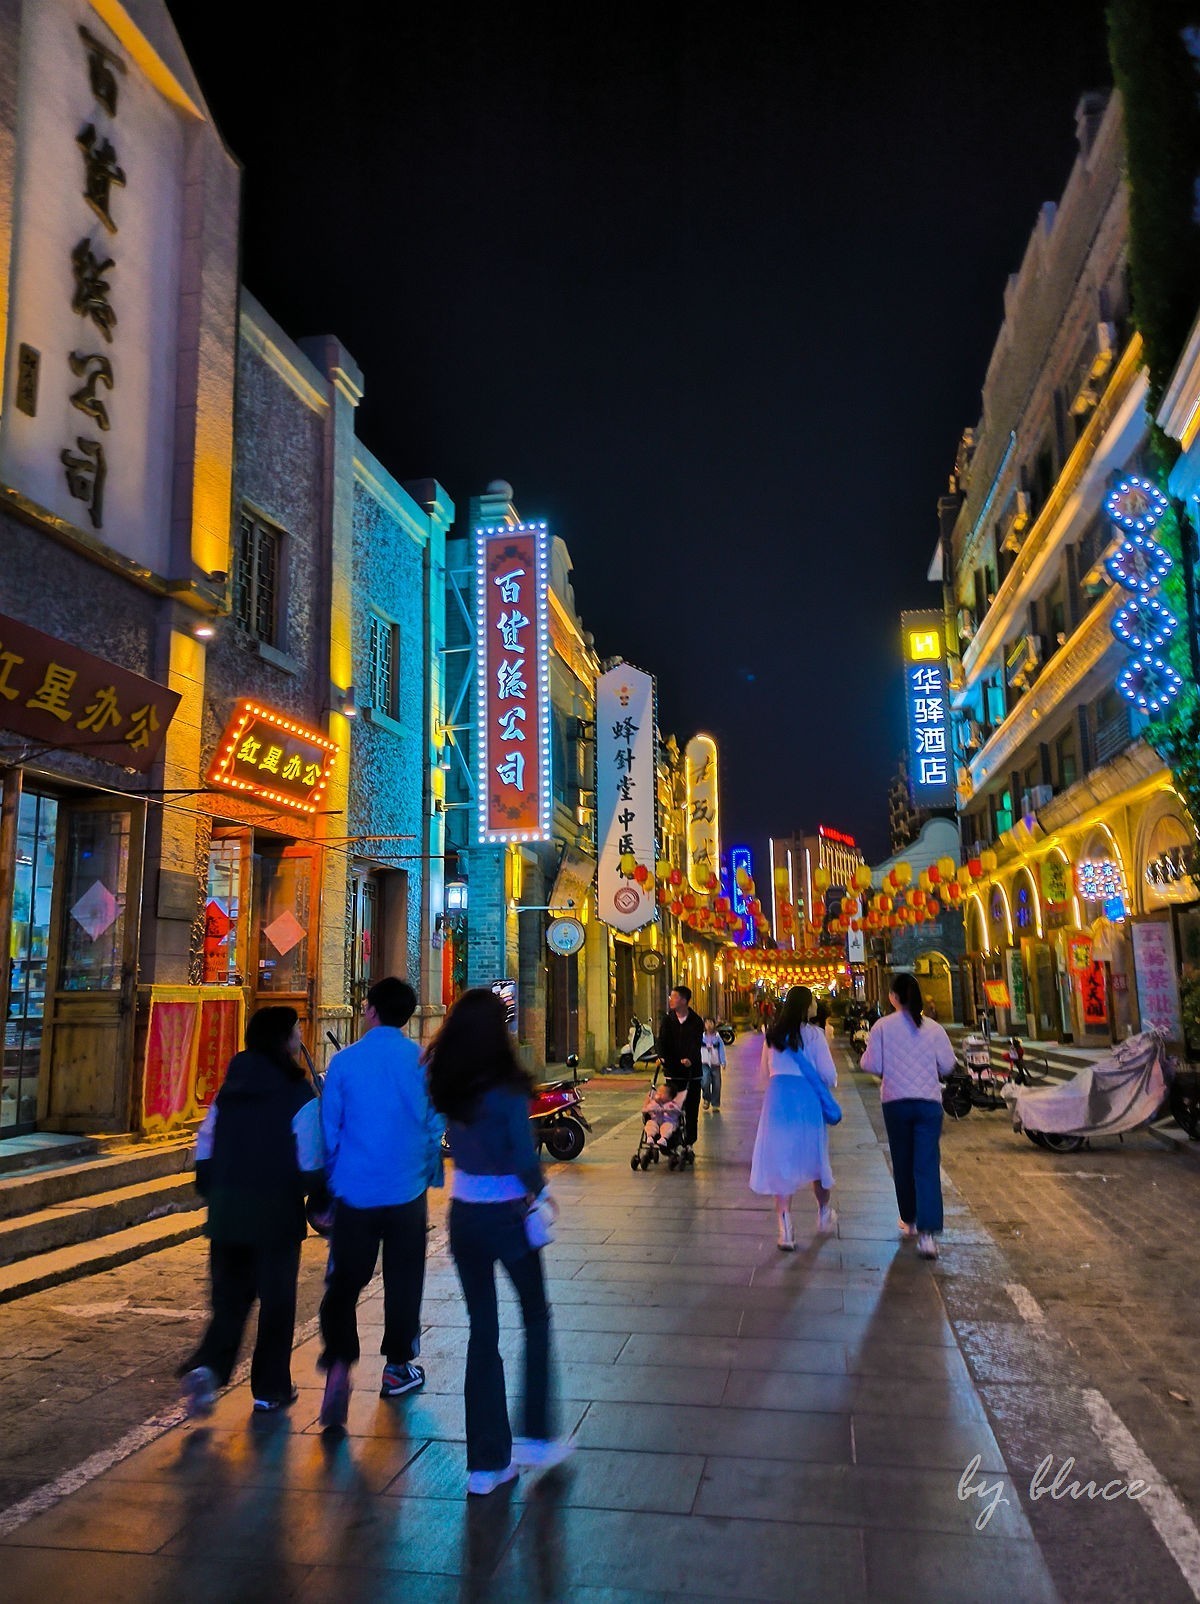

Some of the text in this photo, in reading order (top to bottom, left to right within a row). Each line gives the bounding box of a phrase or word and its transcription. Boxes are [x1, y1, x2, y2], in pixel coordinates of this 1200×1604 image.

[236, 735, 322, 786] 红星办公
[912, 667, 948, 785] 华驿酒店
